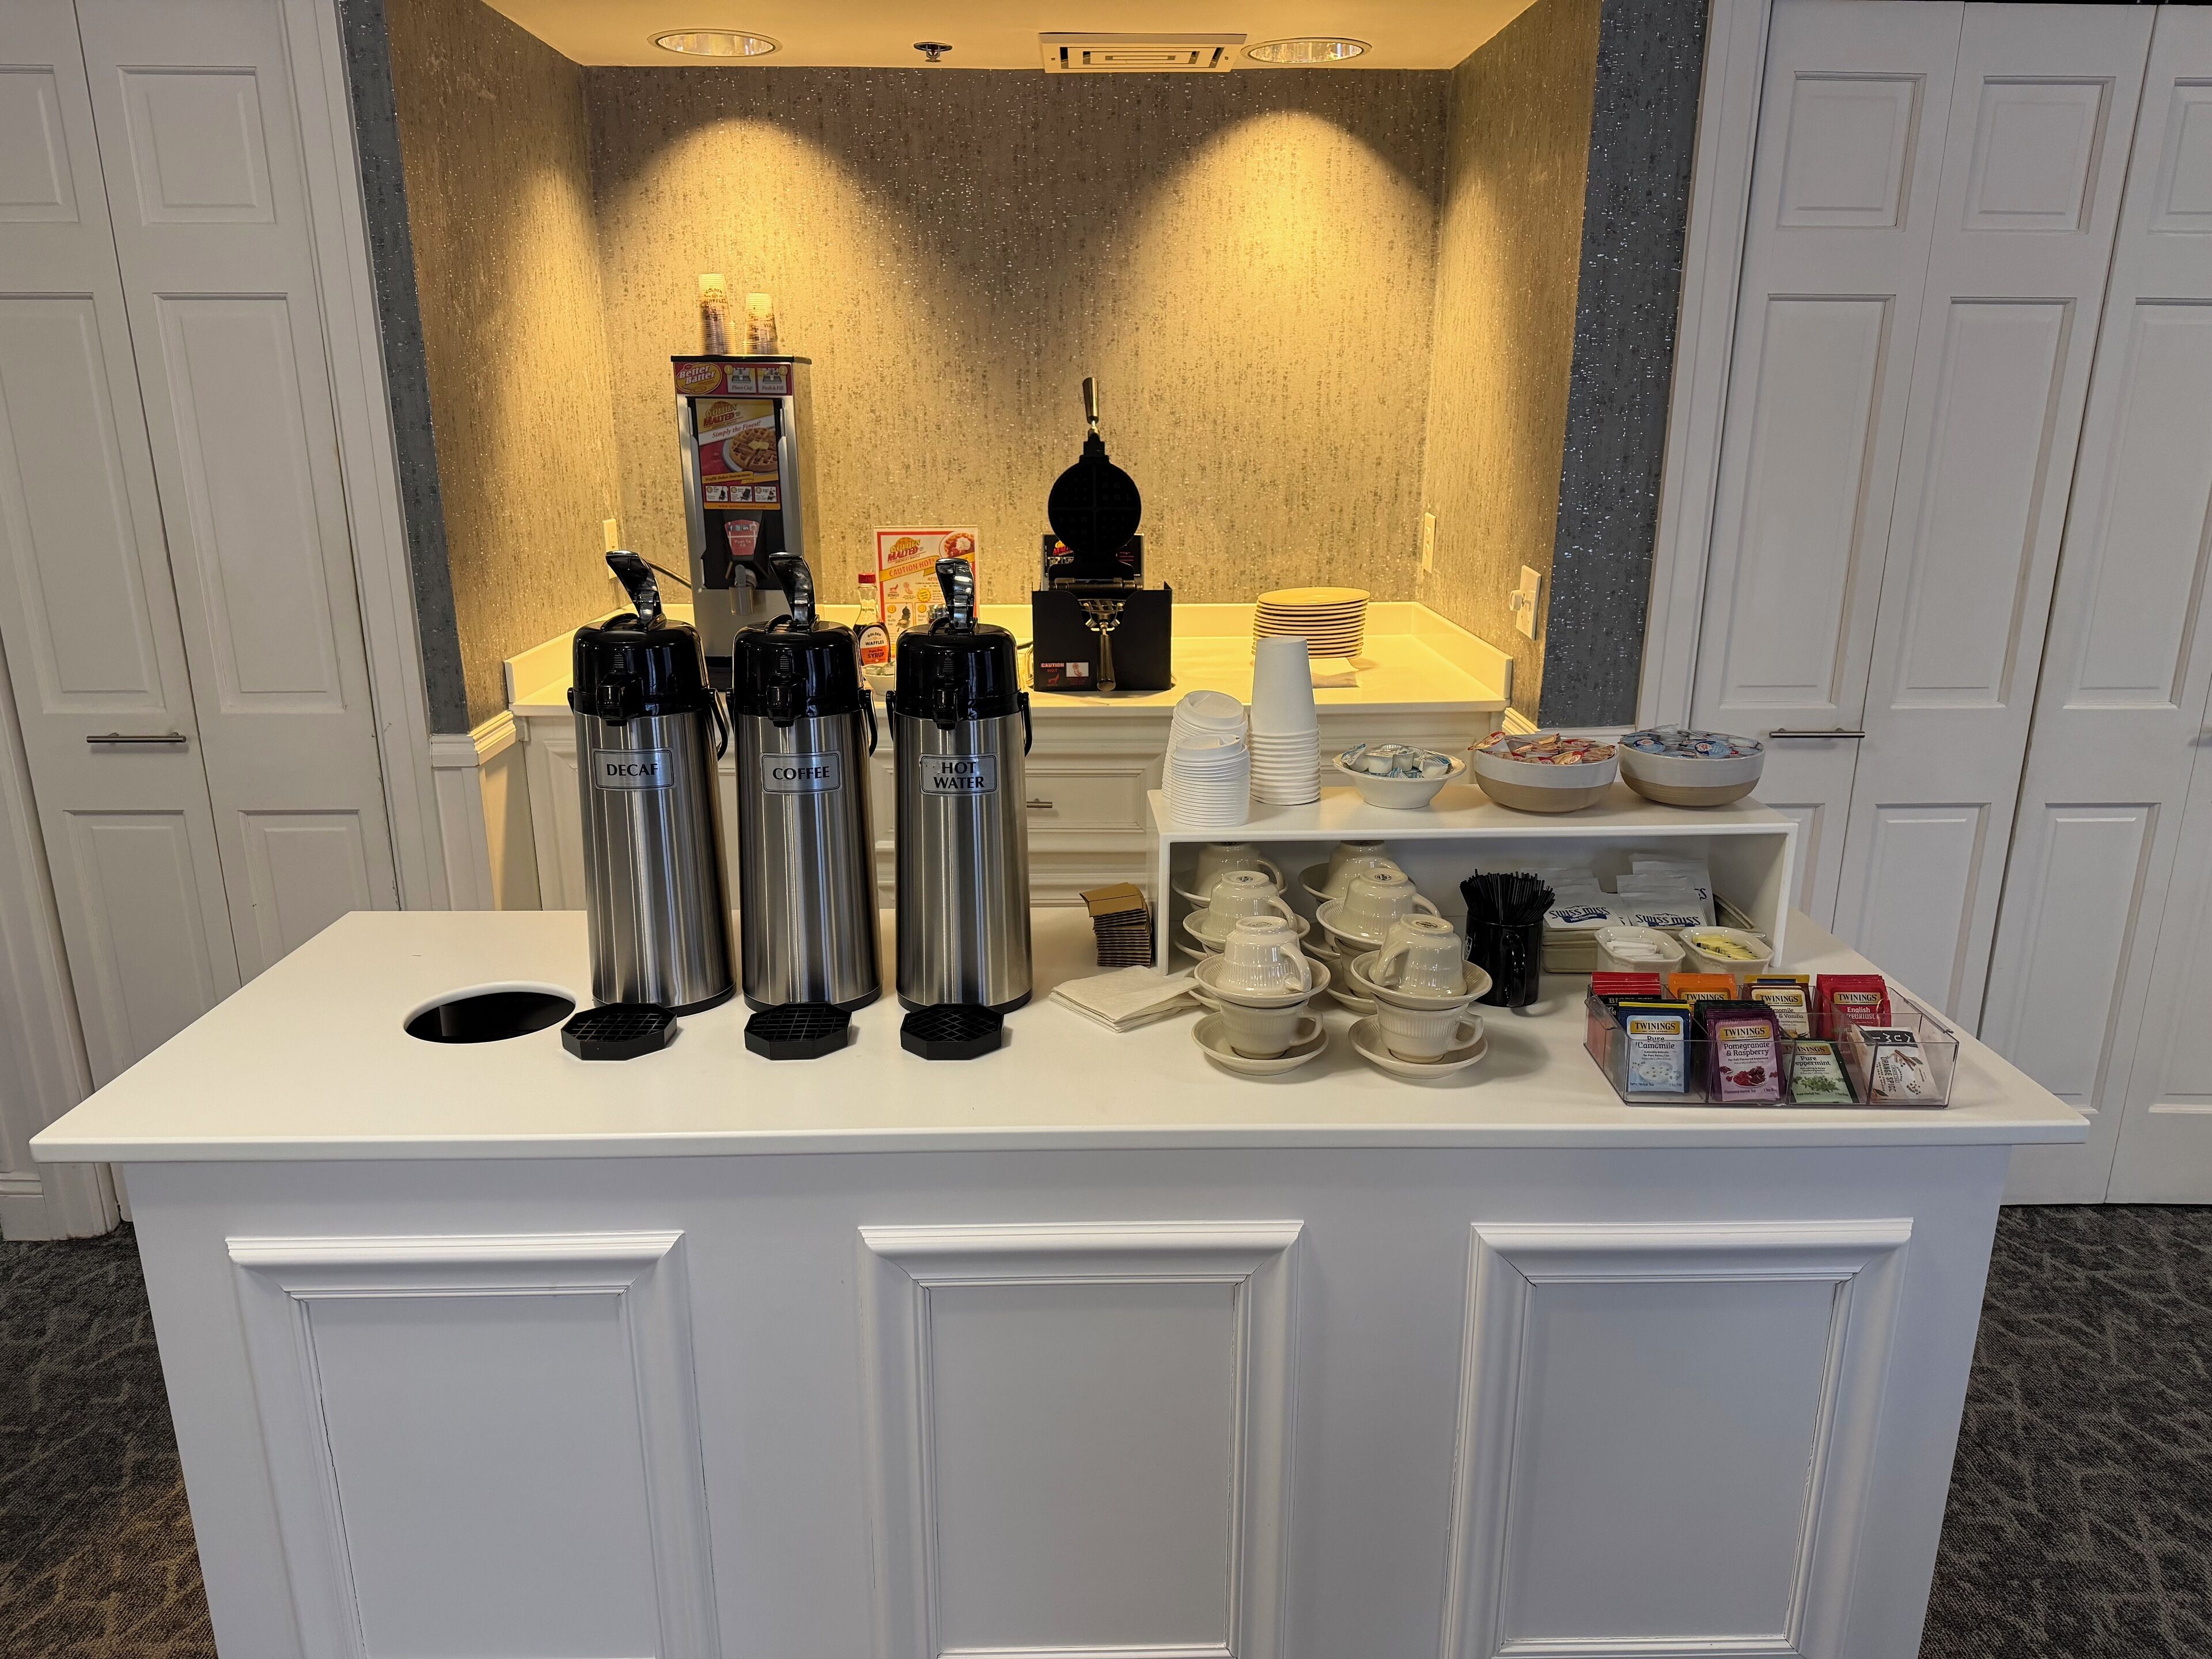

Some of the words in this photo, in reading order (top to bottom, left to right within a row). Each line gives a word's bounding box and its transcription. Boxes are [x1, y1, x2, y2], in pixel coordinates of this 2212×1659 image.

[679, 365, 710, 379] Better
[685, 371, 715, 385] Batter
[703, 412, 735, 426] MALTED
[712, 428, 732, 438] Simply
[733, 425, 742, 433] the
[743, 420, 761, 430] Finest!
[890, 539, 921, 553] GOLDEN
[888, 547, 919, 562] MALTED
[889, 563, 918, 577] CAUTION
[607, 763, 658, 777] DECAF
[772, 766, 830, 780] COFFEE
[942, 762, 976, 774] HOT
[933, 777, 984, 789] WATER
[1724, 1027, 1765, 1036] TWININGS
[1724, 1042, 1770, 1050] Pomegranate
[1880, 1056, 1892, 1076] ORANGE
[1886, 1076, 1896, 1092] SPICE
